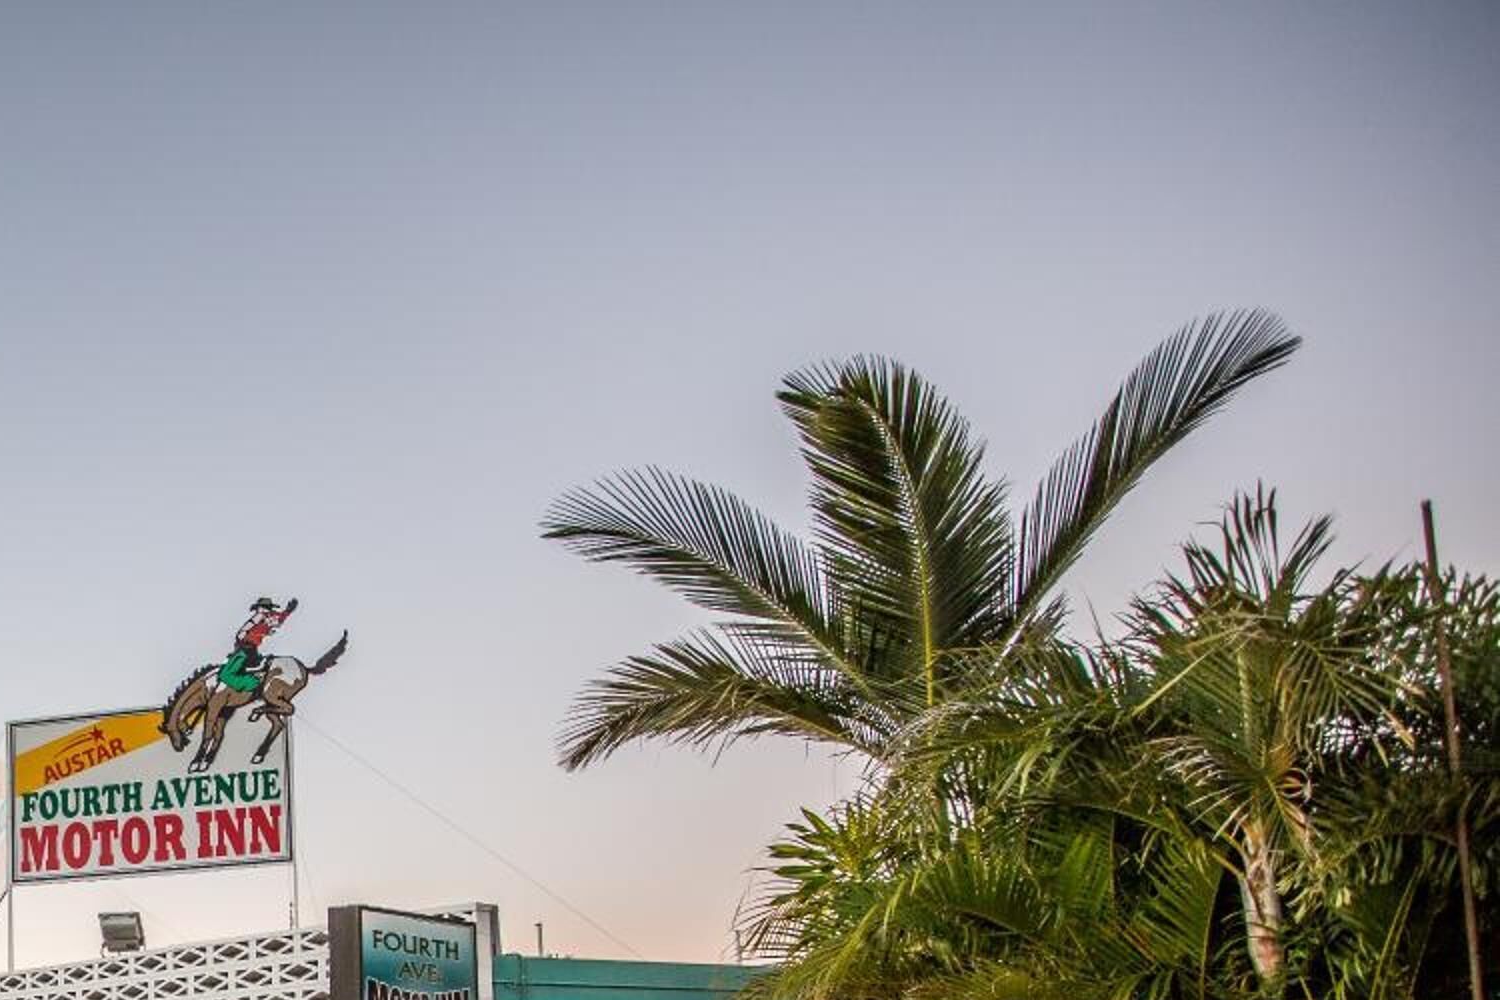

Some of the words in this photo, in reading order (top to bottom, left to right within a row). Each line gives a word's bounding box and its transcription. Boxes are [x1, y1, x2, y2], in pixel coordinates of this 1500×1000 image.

[44, 738, 125, 785] AUSTAR
[21, 782, 143, 822] FOURTH
[150, 768, 281, 810] AVENUE
[20, 814, 186, 873] MOTOR
[196, 805, 281, 858] INN
[372, 930, 459, 960] FOURTH
